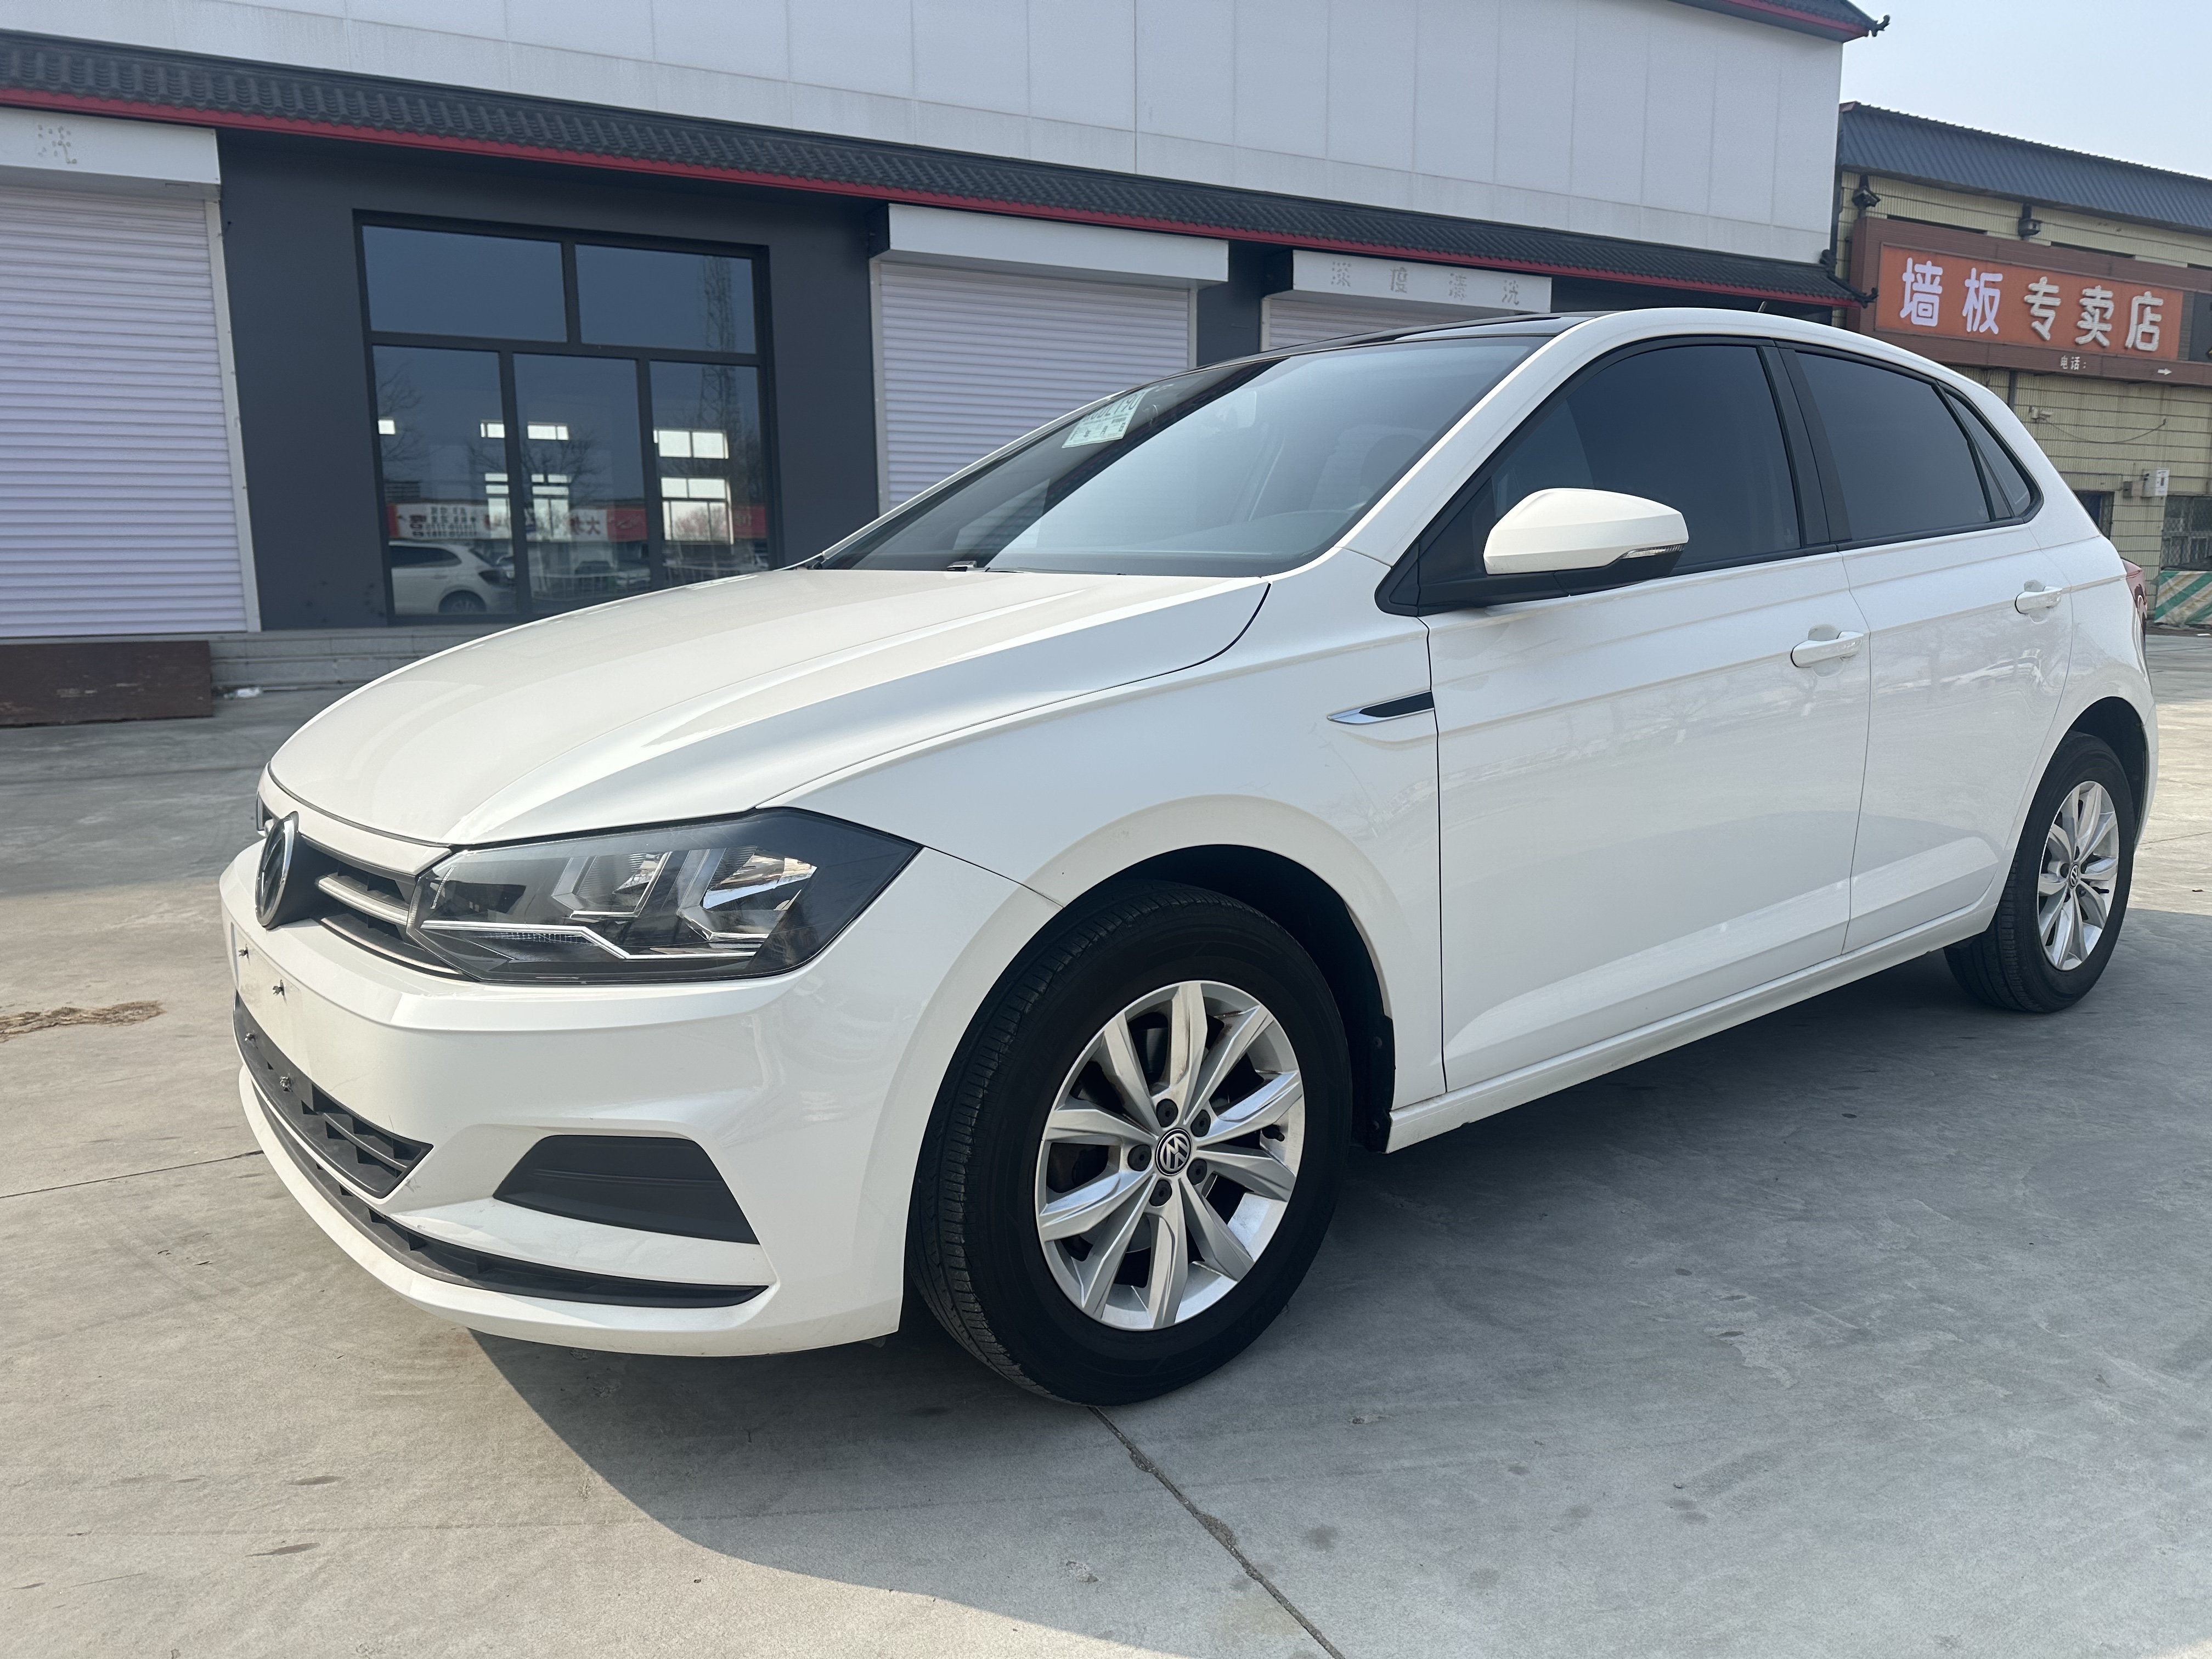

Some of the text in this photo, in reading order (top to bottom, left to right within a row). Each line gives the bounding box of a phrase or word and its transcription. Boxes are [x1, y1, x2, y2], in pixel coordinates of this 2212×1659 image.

[1900, 257, 2163, 352] 墙板专卖店
